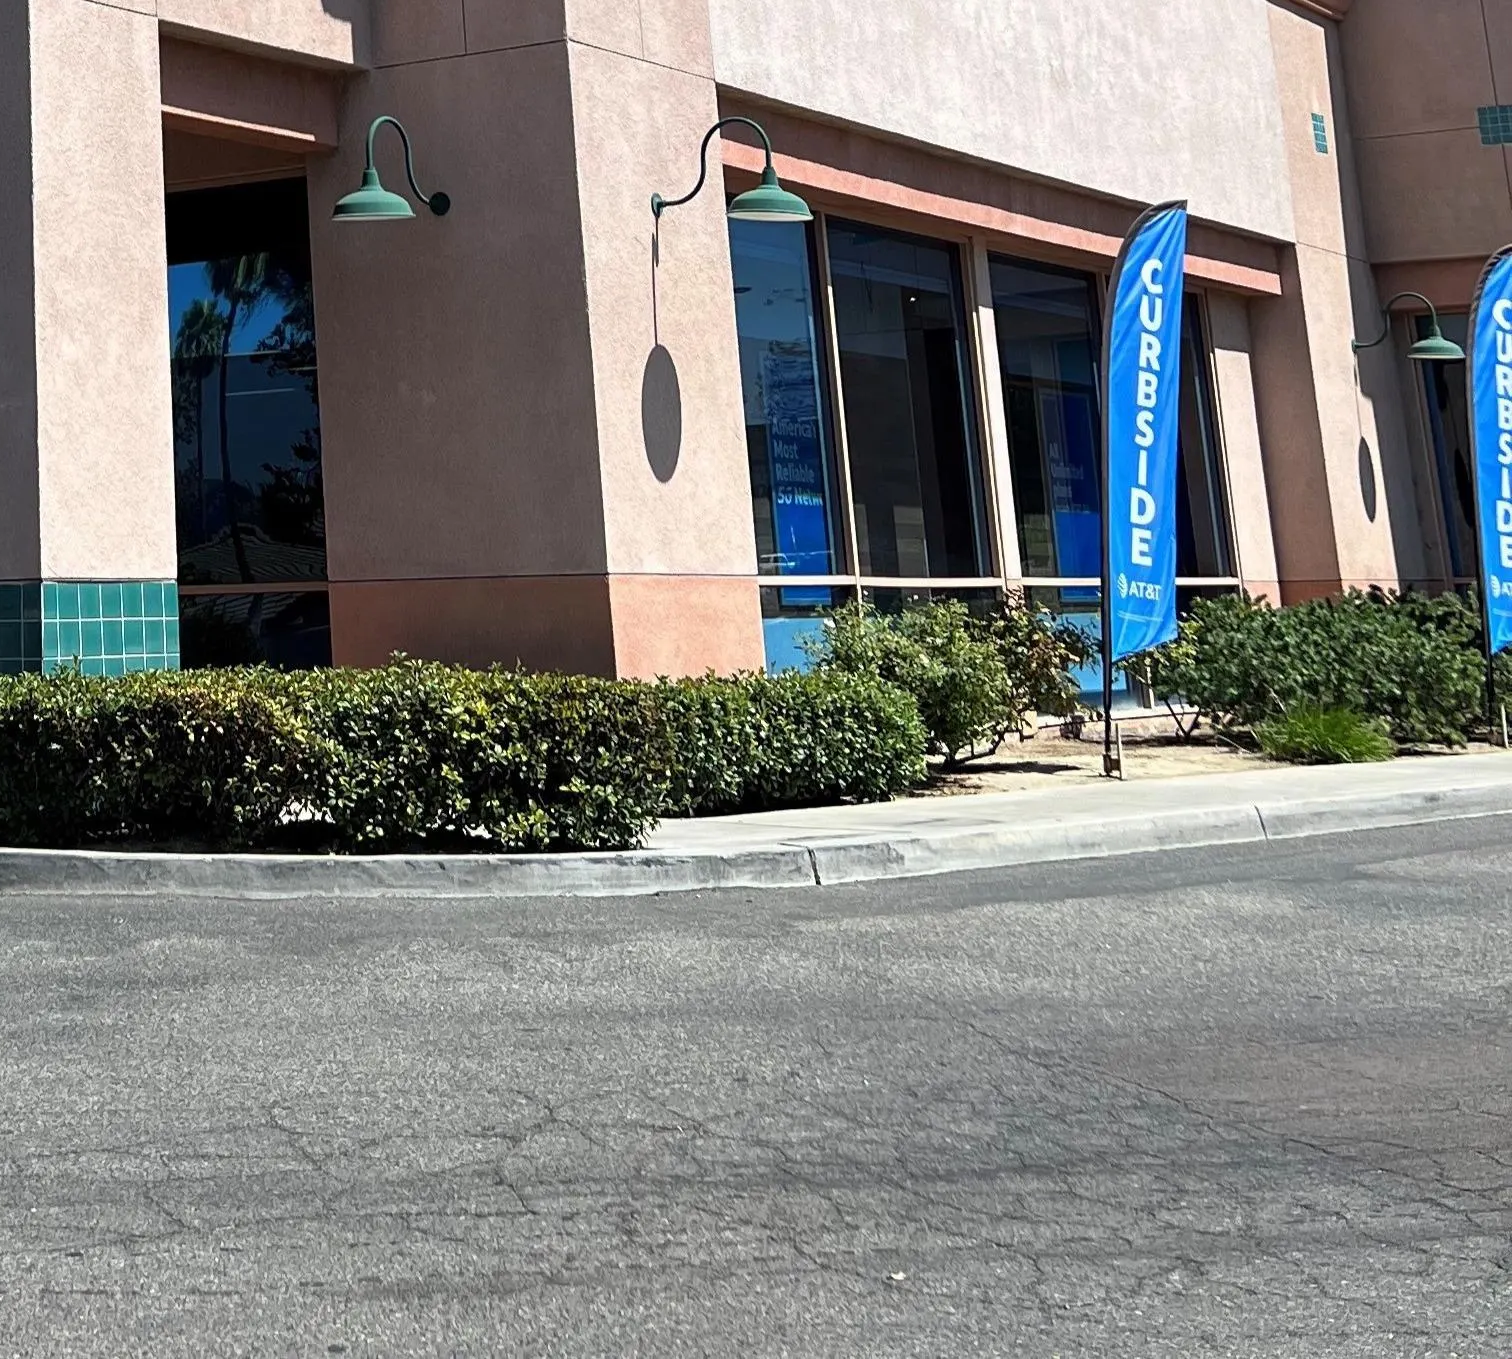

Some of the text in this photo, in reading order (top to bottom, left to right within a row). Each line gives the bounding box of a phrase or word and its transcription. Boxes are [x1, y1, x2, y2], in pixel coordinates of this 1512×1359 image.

[1130, 257, 1164, 567] CURBSIDE
[774, 440, 800, 460] Most
[776, 462, 815, 484] Reliable
[1128, 581, 1162, 600] AT&T
